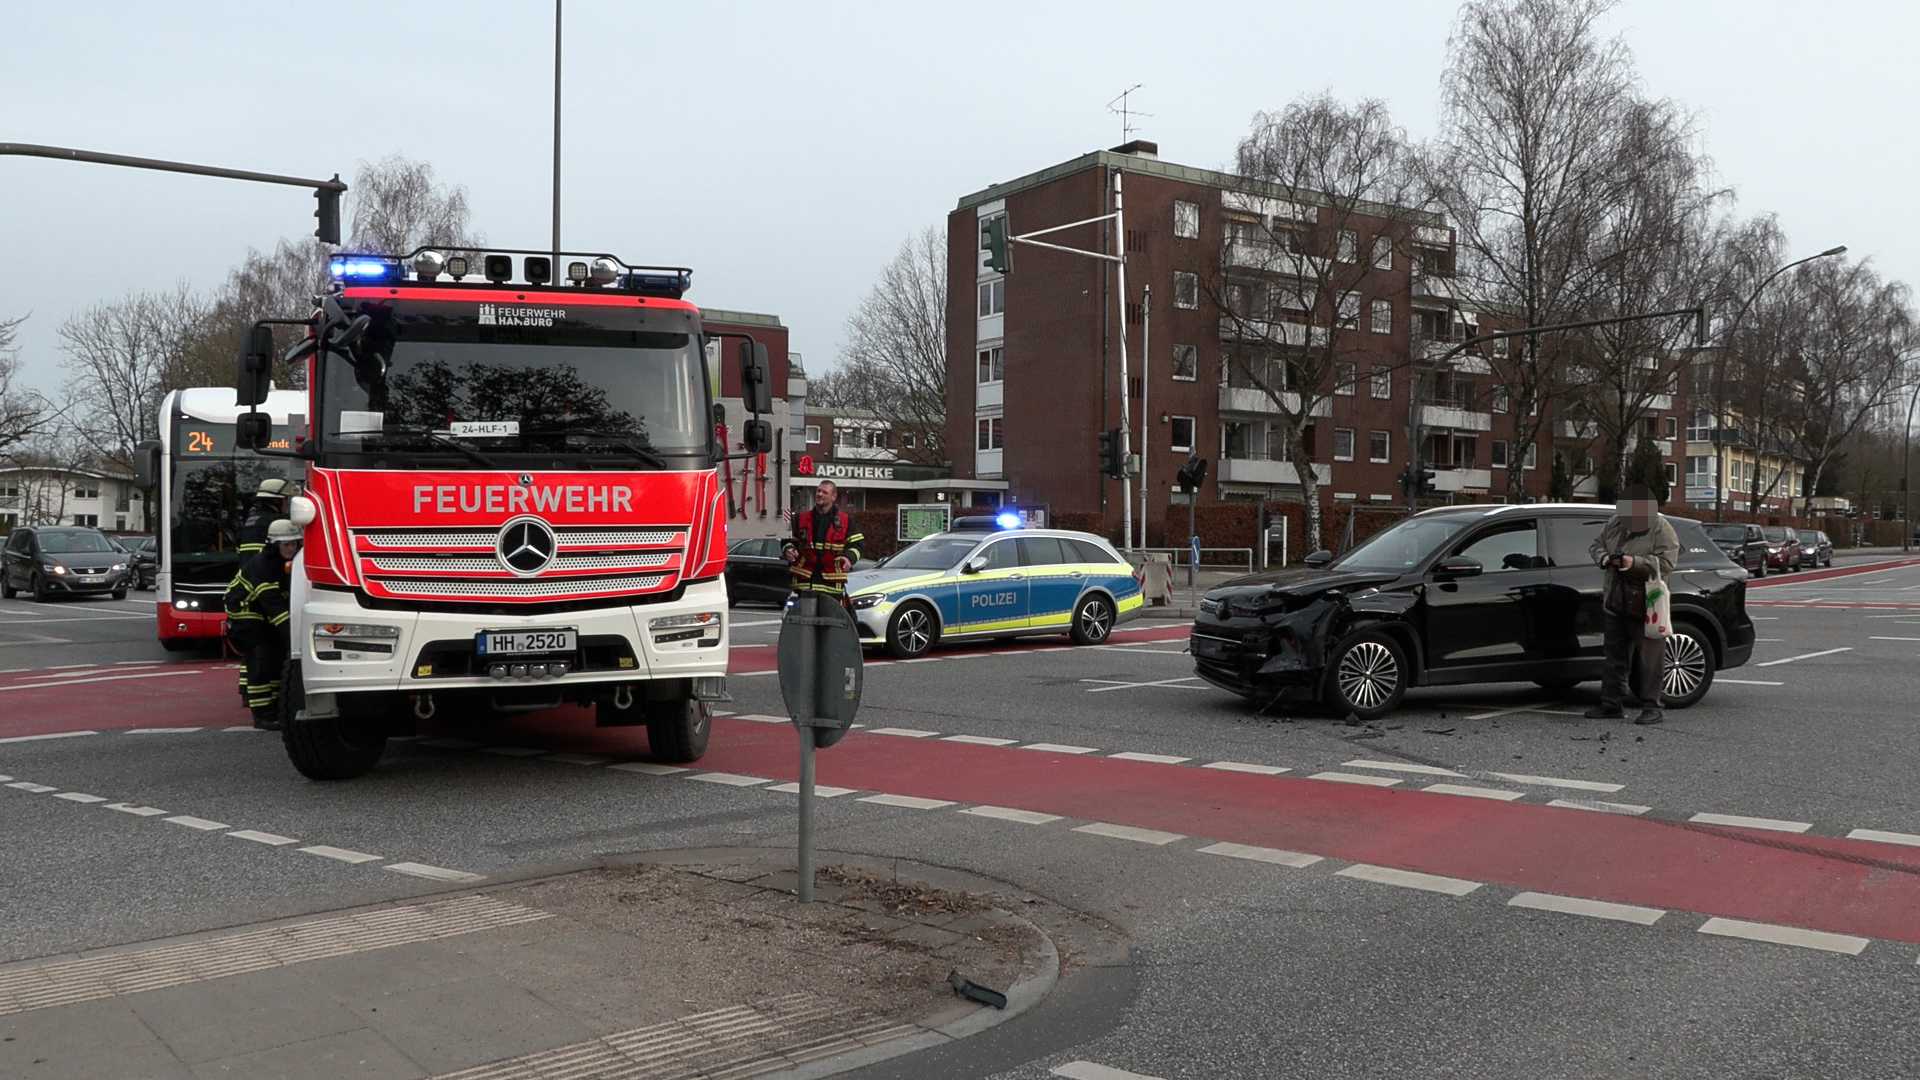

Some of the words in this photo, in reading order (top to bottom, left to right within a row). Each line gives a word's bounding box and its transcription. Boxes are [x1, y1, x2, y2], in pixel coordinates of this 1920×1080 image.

[498, 307, 566, 319] FEUERWEHR
[498, 316, 553, 327] HAMBURG
[462, 425, 507, 434] 24-HLF-1
[188, 431, 214, 452] 24
[816, 464, 894, 479] APOTHEKE
[413, 485, 634, 513] FEUERWEHR
[971, 592, 1017, 607] POLIZEI
[493, 635, 515, 651] HH
[526, 634, 566, 650] 2520
